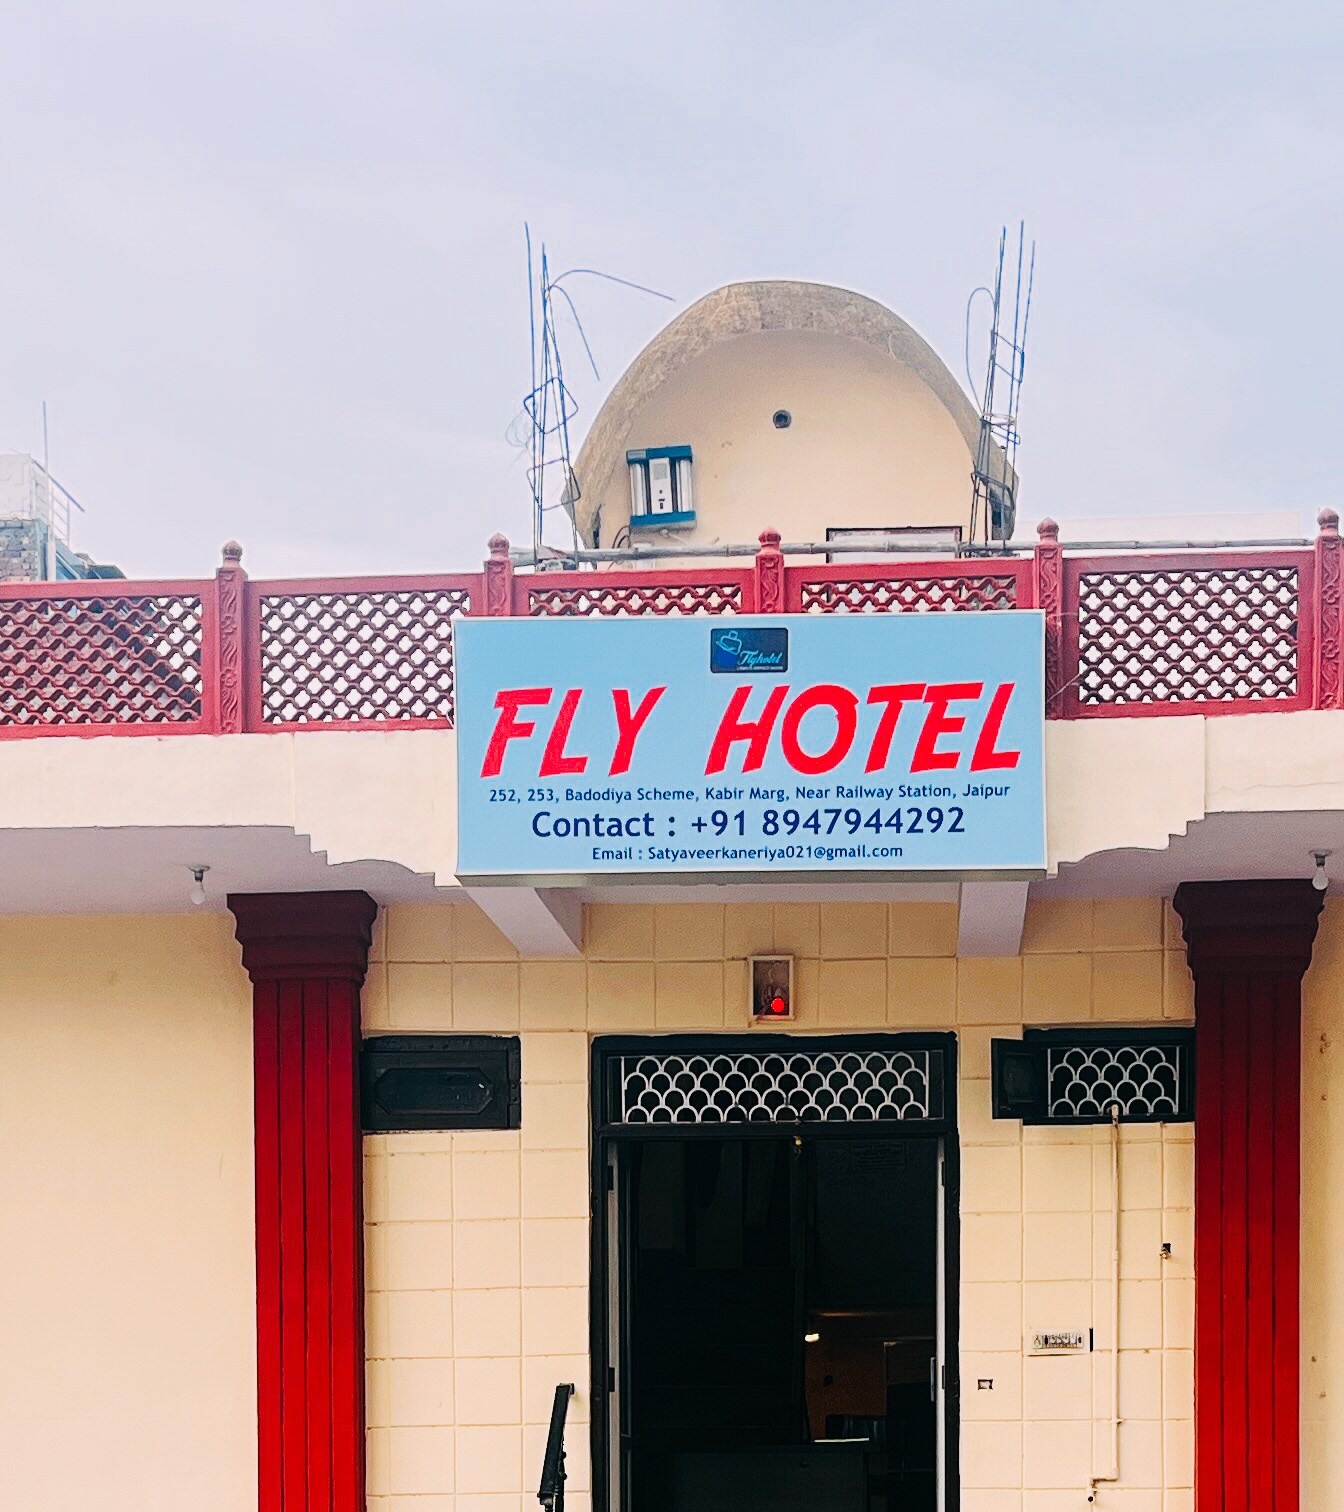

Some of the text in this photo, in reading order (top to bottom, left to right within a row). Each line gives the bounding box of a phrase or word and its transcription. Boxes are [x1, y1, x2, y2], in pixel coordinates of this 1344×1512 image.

[481, 682, 1021, 778] FLY HOTEL
[490, 784, 1010, 803] 252, 253, Badodiya Scheme, Kabir Marg, Near Railway Station, Jaipur
[532, 811, 655, 837] Contact
[691, 809, 745, 836] +91
[762, 806, 965, 836] 8947944292
[592, 846, 633, 860] Email
[648, 845, 903, 862] Satyaveerkaneriya021@gmail.com
